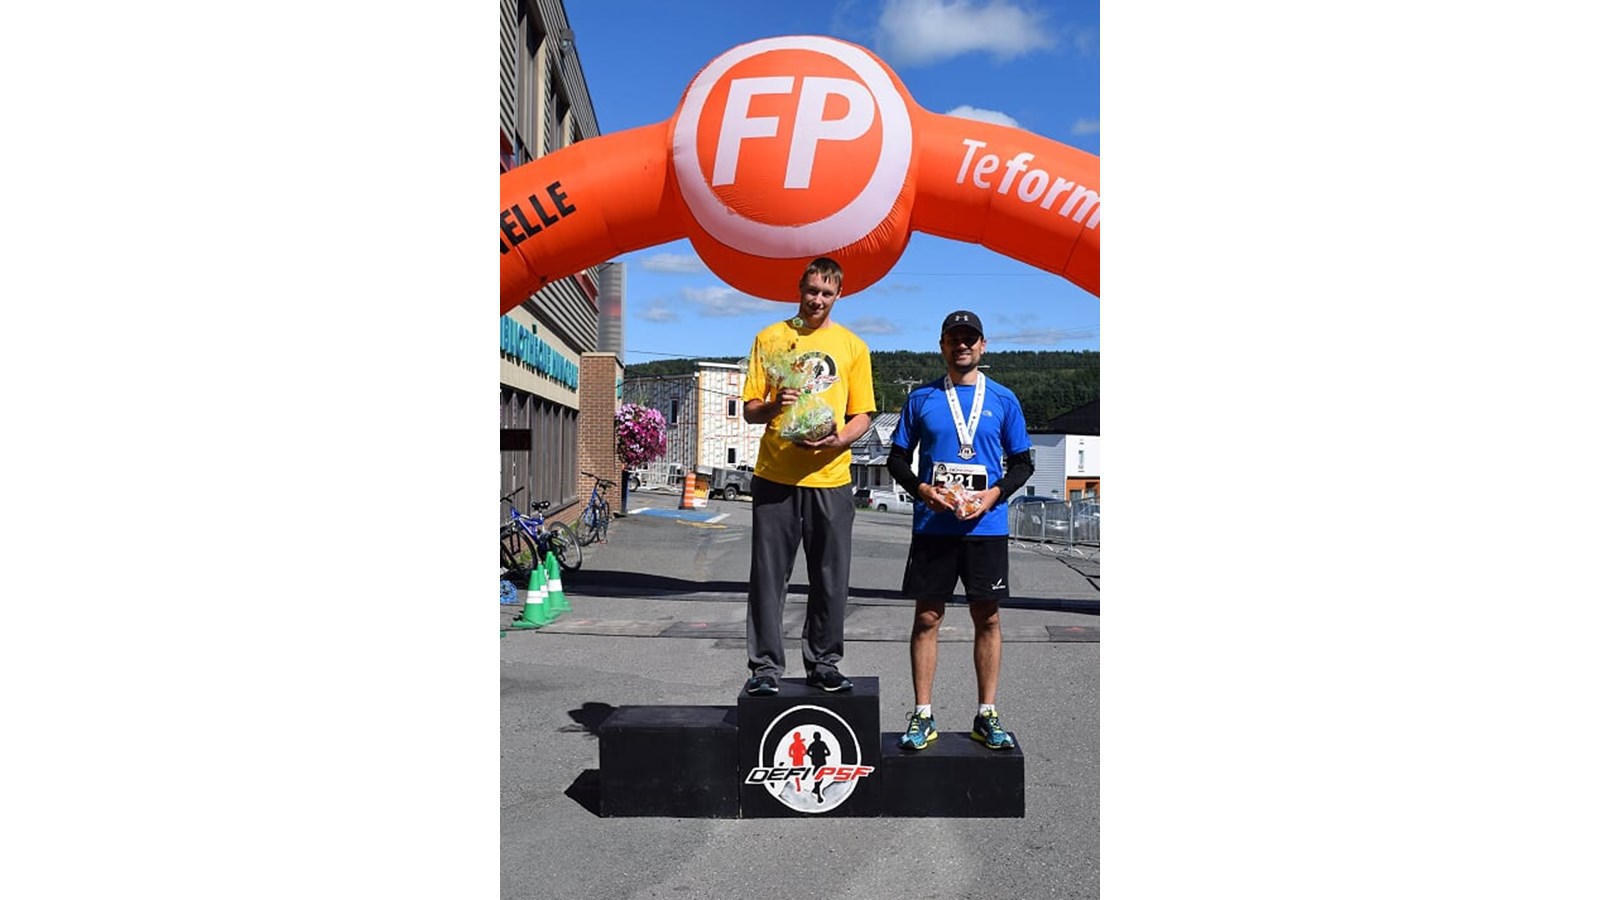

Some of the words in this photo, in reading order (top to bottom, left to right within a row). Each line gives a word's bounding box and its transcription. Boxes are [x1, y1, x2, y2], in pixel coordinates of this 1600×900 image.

[712, 75, 876, 190] FP
[500, 180, 577, 254] ELLE
[746, 761, 812, 784] DÉFI
[813, 766, 873, 783] PSF
